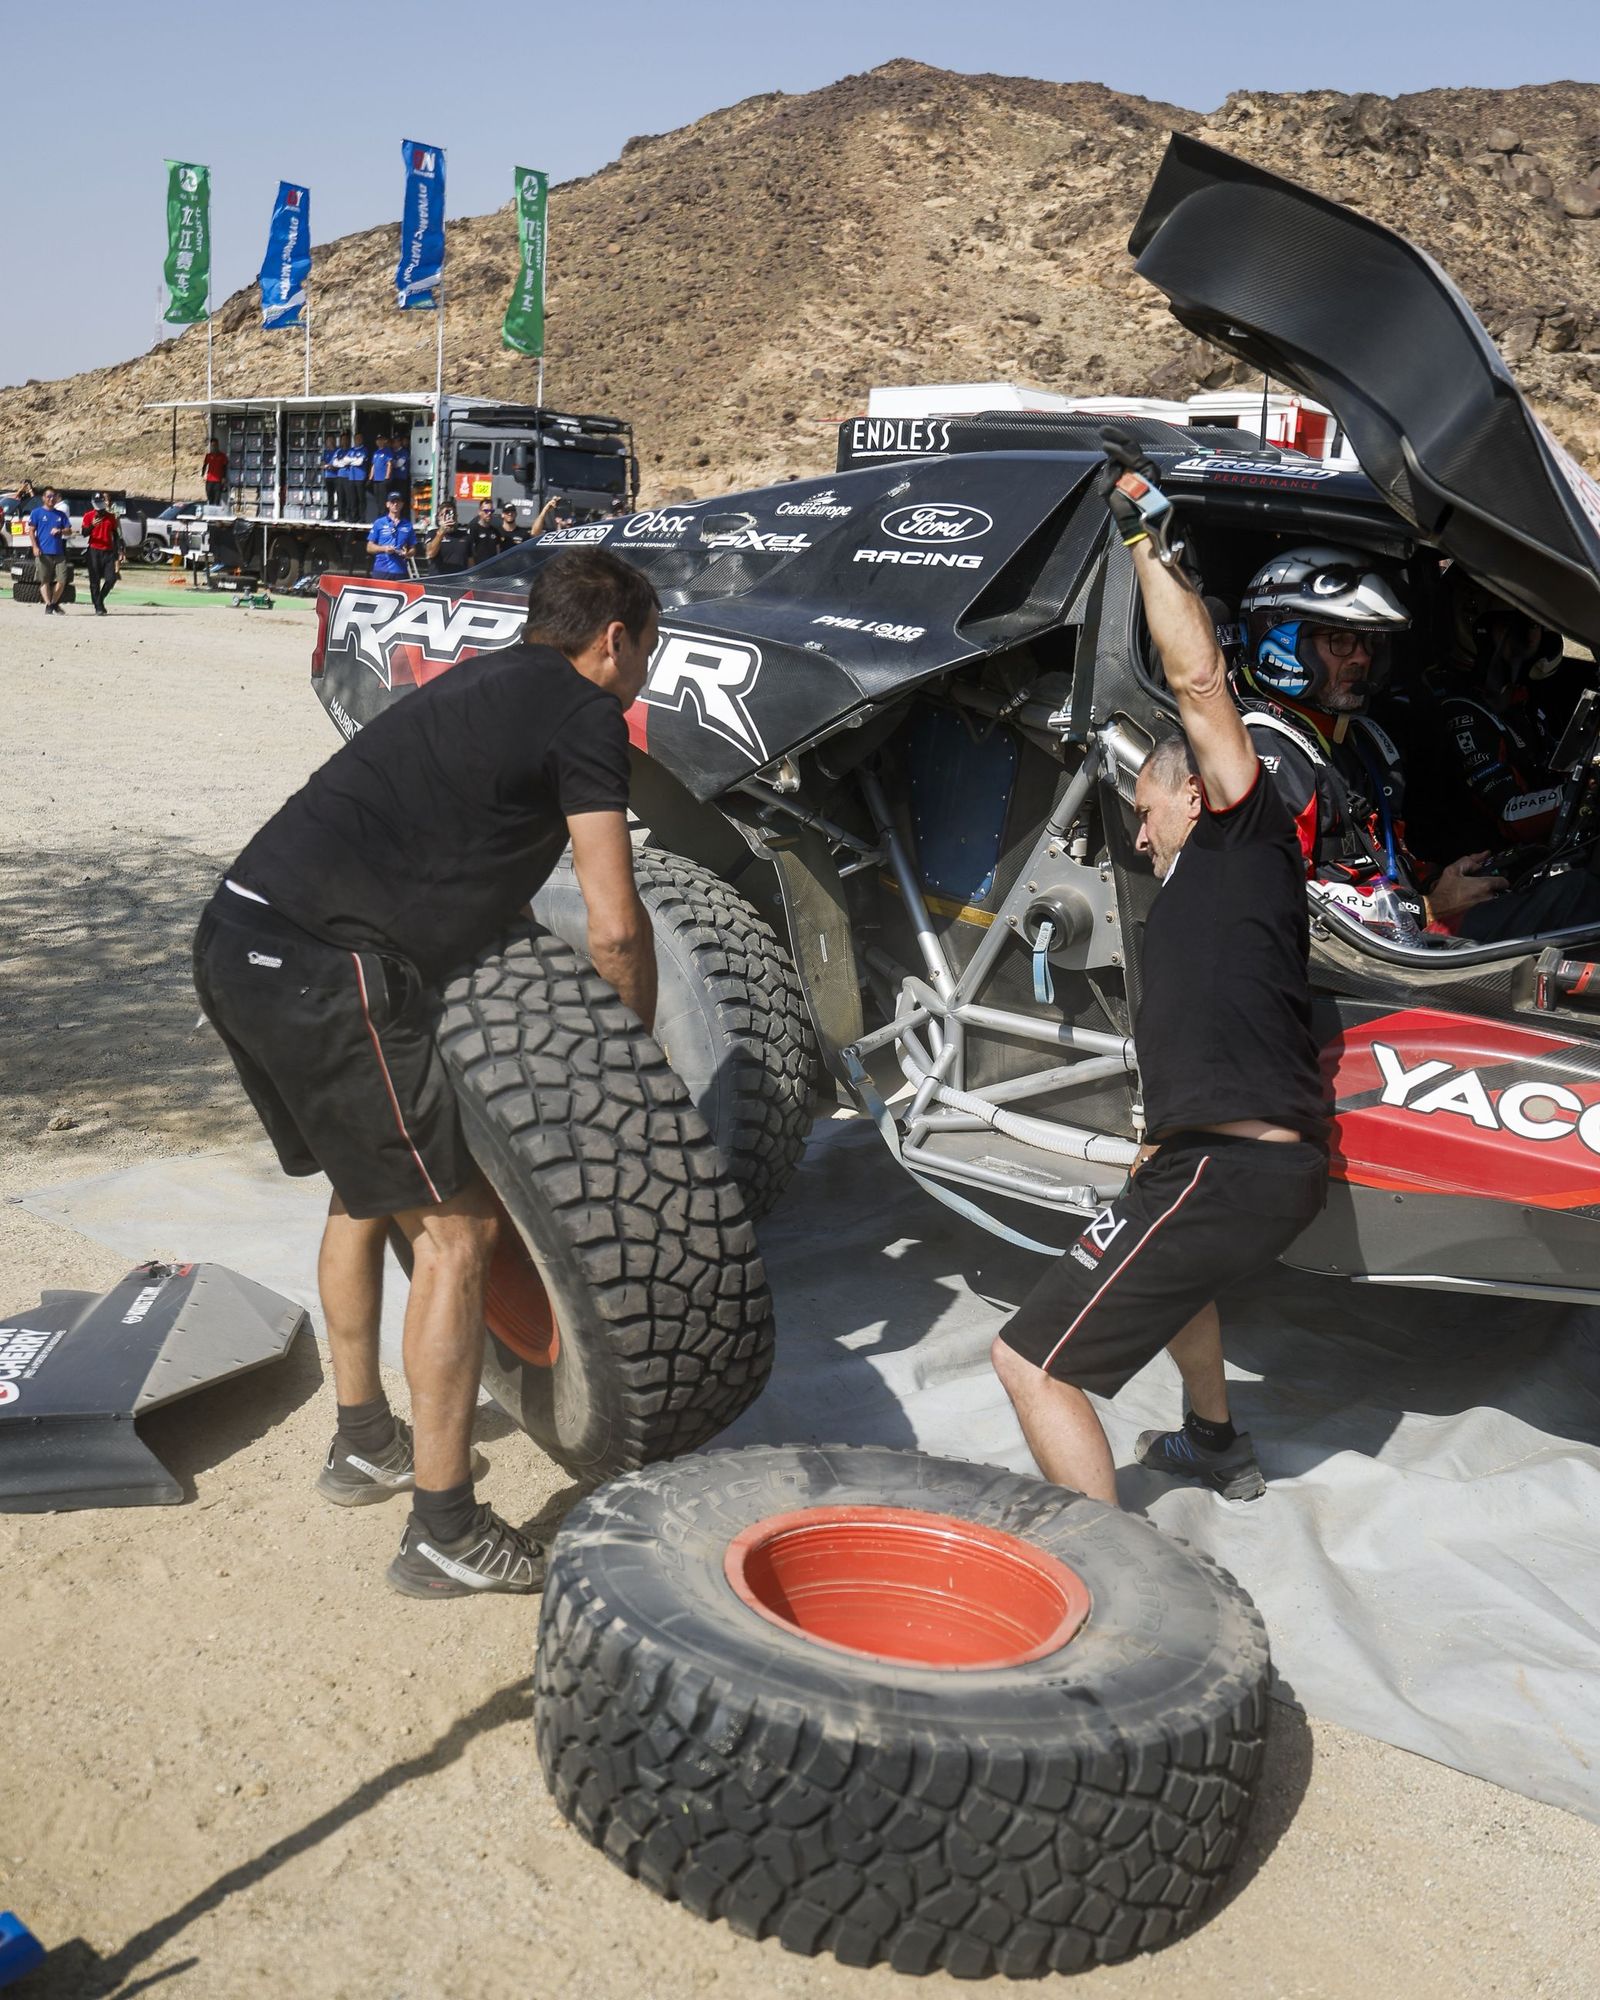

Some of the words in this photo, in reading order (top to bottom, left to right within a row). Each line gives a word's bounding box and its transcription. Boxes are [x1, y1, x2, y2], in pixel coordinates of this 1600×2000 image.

[852, 420, 951, 450] ENDLESS
[1176, 458, 1341, 480] AEROSPEED
[1214, 474, 1320, 490] PERFORMANCE
[775, 501, 852, 519] CroisiEurope
[898, 508, 974, 537] Ford
[543, 526, 607, 544] sparco
[853, 550, 984, 569] RACING
[811, 615, 864, 631] PHIL
[866, 621, 928, 640] LONG
[330, 697, 357, 737] MAURIN
[1371, 1041, 1600, 1155] YAC
